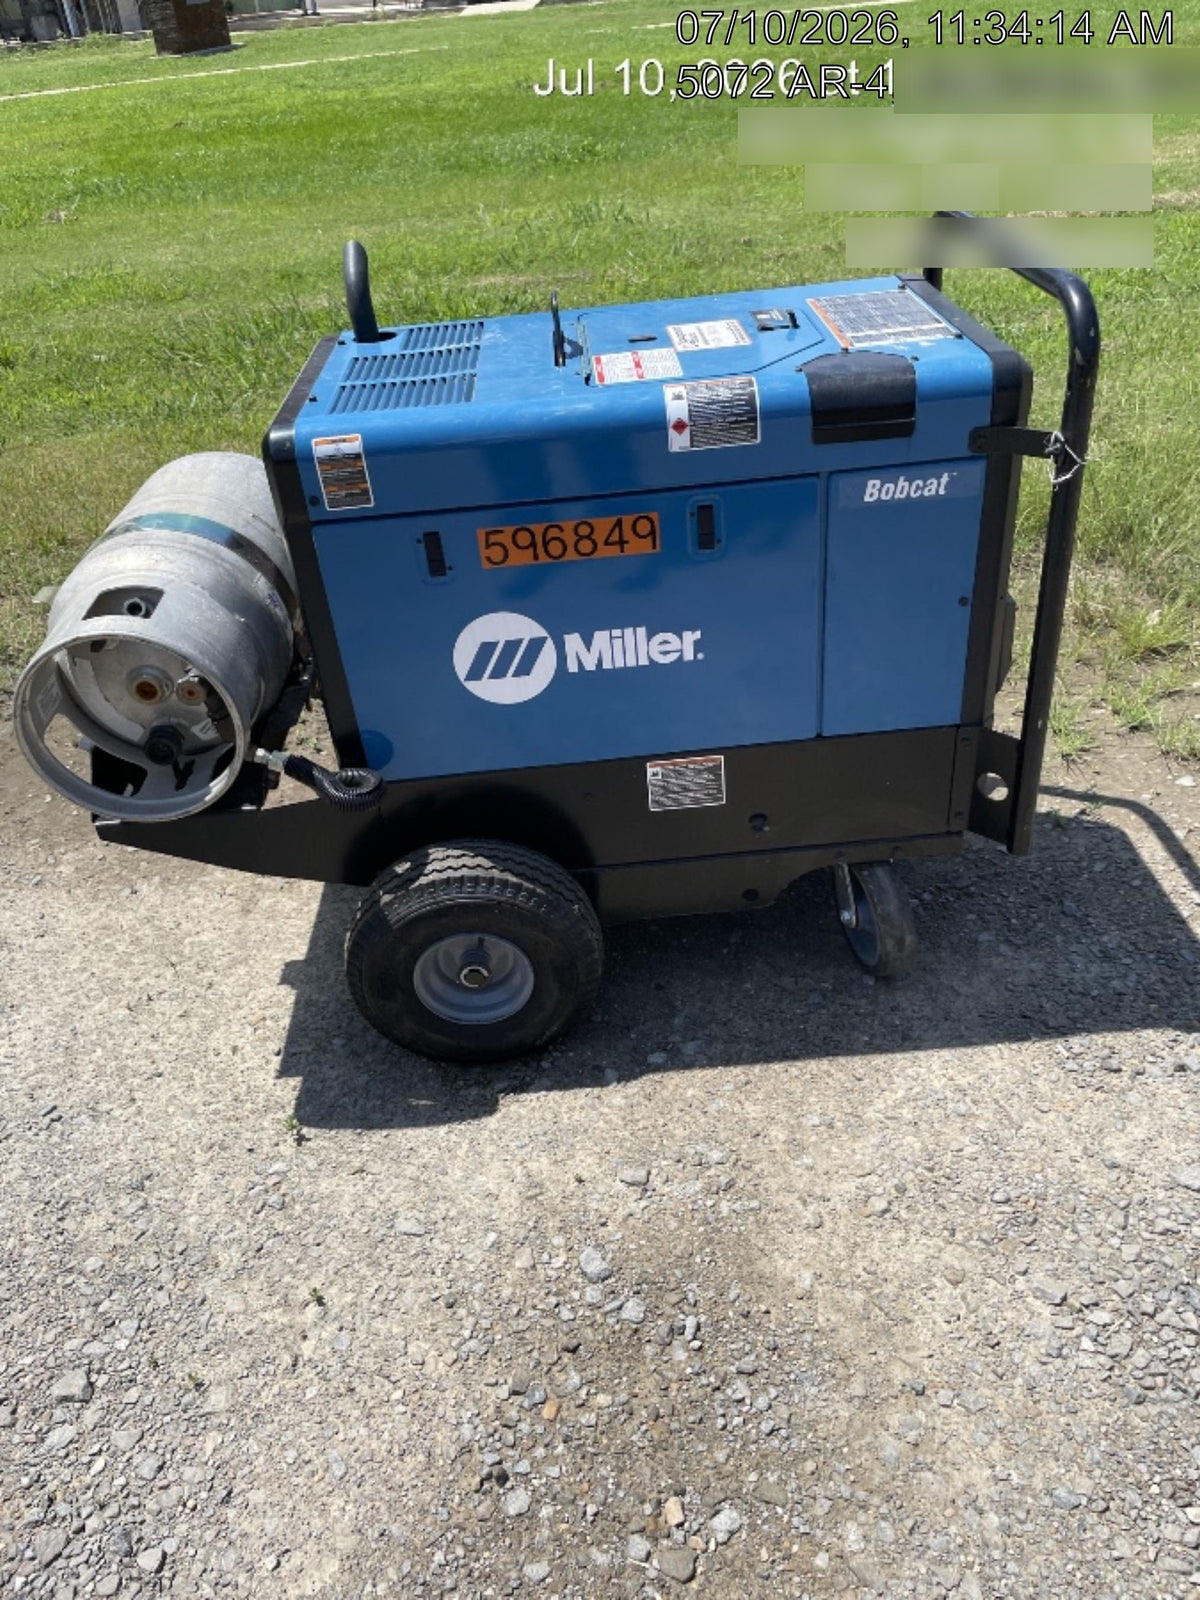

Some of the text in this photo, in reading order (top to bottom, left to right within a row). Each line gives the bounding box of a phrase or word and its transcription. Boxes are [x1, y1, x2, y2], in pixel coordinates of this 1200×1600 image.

[863, 472, 950, 502] Bobcat
[484, 514, 657, 566] 596849
[563, 626, 701, 673] Miller
